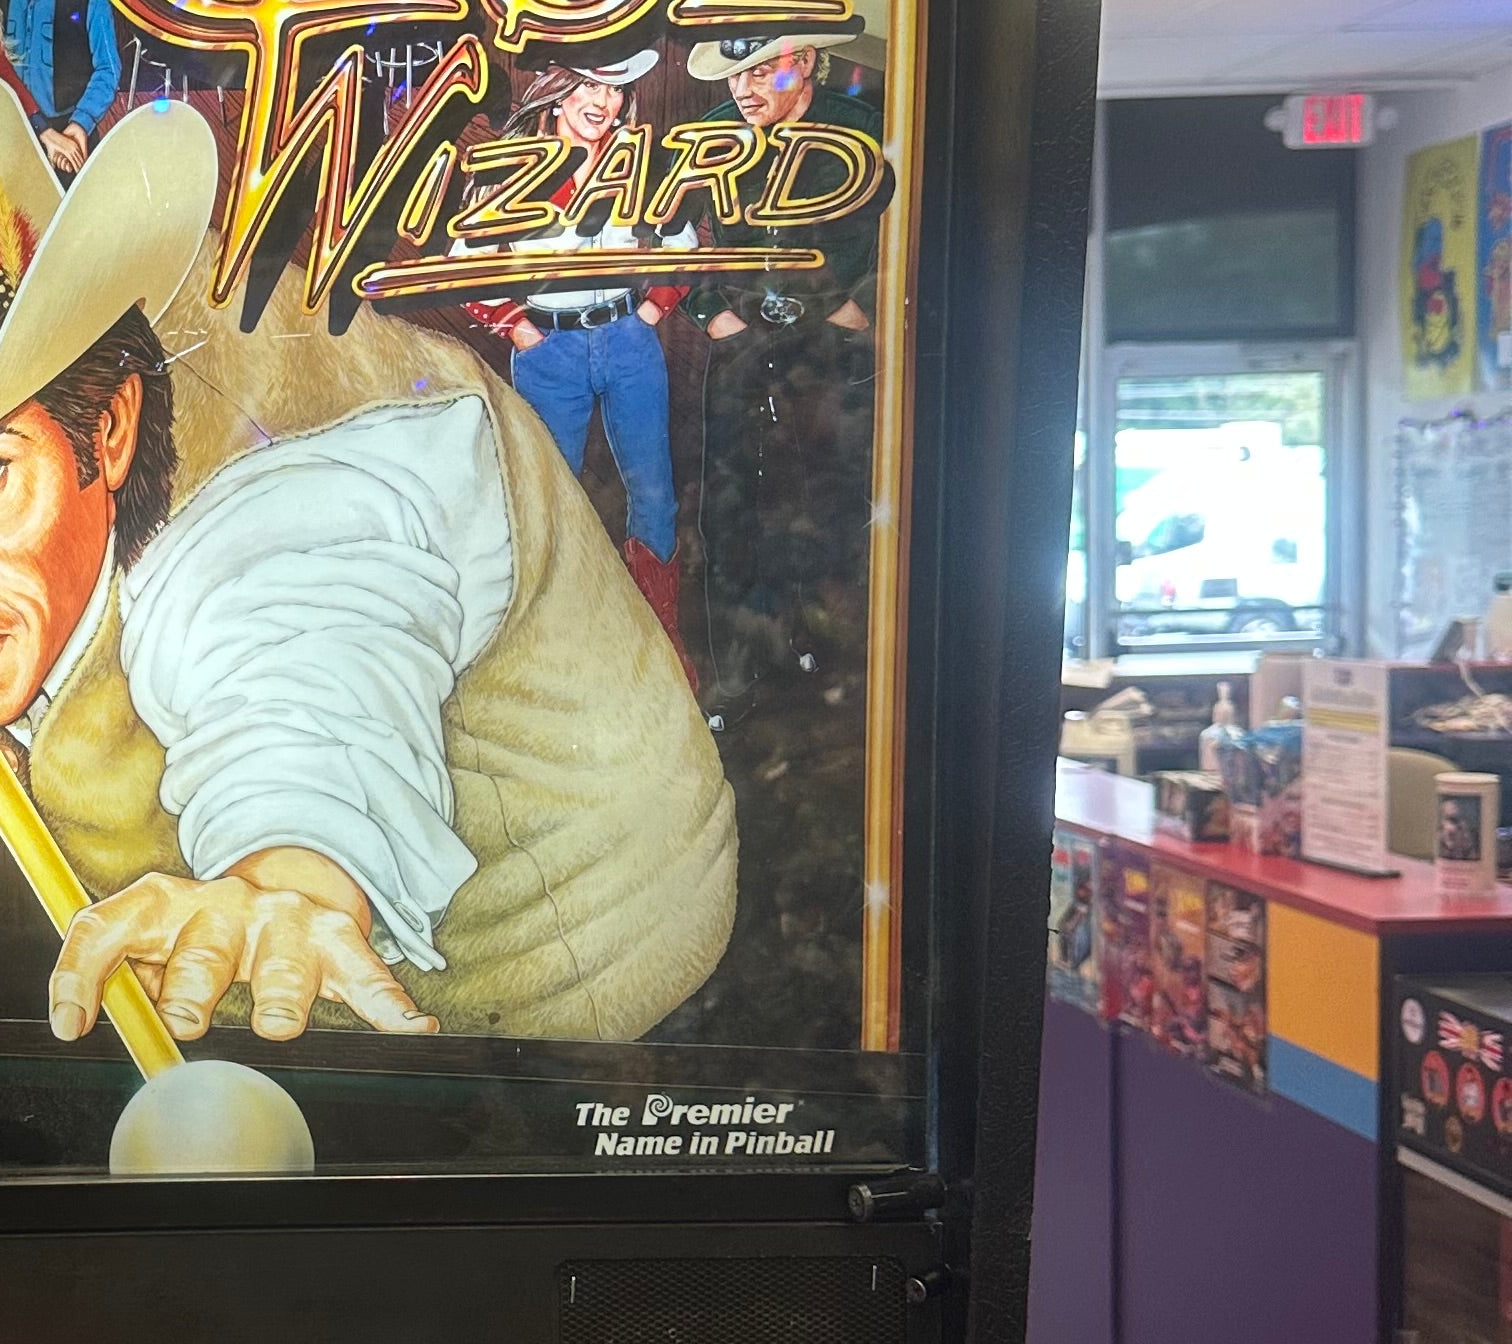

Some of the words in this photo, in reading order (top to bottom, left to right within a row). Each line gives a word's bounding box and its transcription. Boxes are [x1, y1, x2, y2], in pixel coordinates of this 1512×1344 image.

[1303, 94, 1364, 144] EXIT
[207, 33, 892, 316] WIZARD
[576, 1103, 631, 1127] The
[641, 1093, 795, 1126] Premier
[594, 1132, 683, 1156] Name
[689, 1131, 720, 1155] in
[724, 1129, 836, 1155] Pinball
